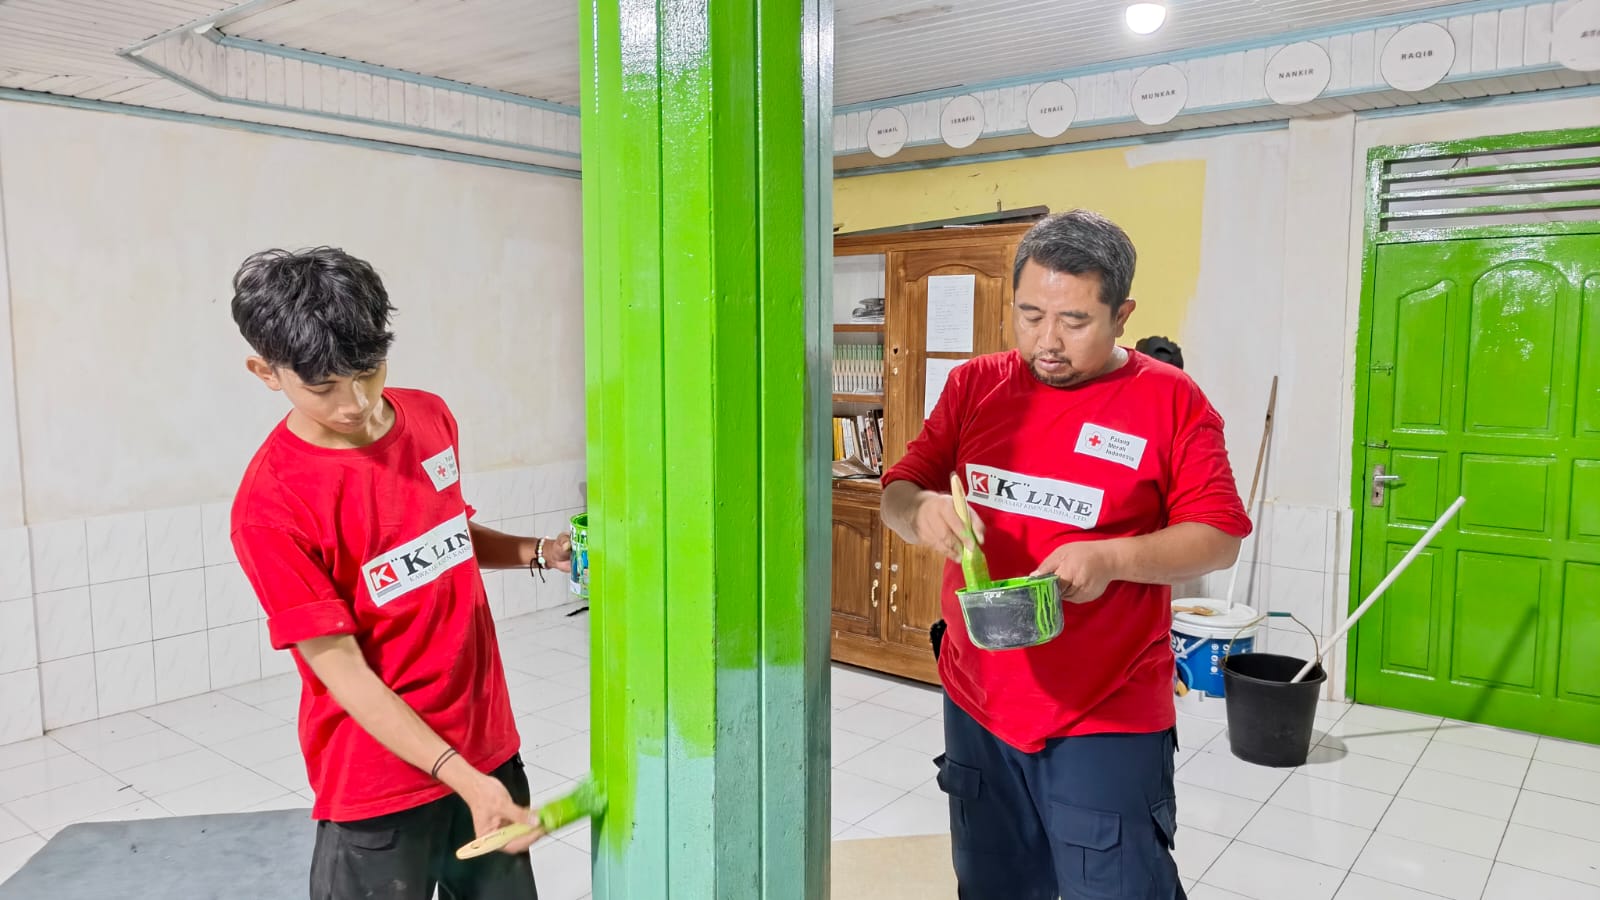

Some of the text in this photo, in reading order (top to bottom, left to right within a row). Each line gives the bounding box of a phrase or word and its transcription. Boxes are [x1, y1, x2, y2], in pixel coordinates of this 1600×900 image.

[1401, 50, 1433, 60] RAQIB
[1279, 68, 1314, 79] NANKIR
[1141, 89, 1176, 100] MUNKAR
[1040, 105, 1064, 114] IZRAIL
[1110, 435, 1130, 446] Palang
[1026, 490, 1093, 517] LINE
[371, 564, 395, 589] K
